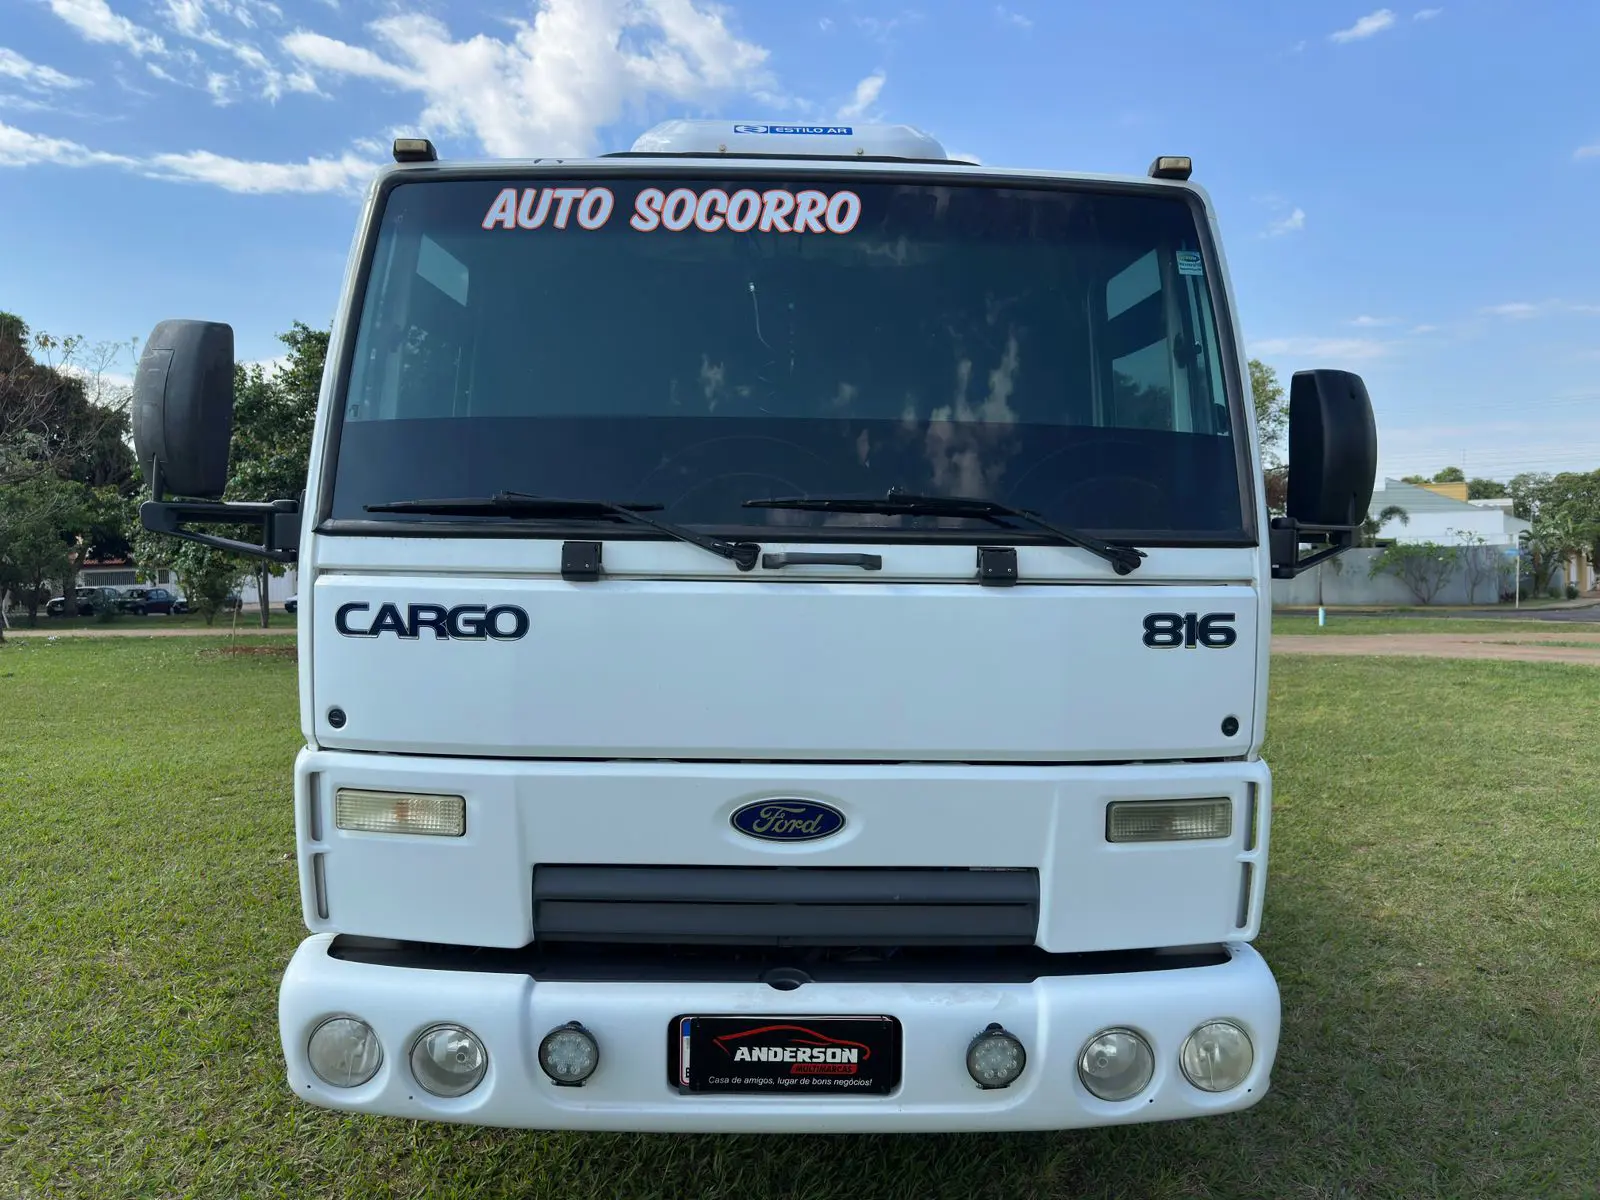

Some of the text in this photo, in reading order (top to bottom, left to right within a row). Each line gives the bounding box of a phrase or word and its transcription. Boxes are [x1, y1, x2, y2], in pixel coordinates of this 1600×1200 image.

[482, 188, 862, 234] AUTO SOCORRO
[335, 602, 530, 641] CARGO
[1142, 612, 1237, 649] 816
[752, 805, 823, 833] Ford
[734, 1046, 858, 1063] ANDERSON
[708, 1076, 873, 1087] Casa de amigos, lugar de bons negócios!
